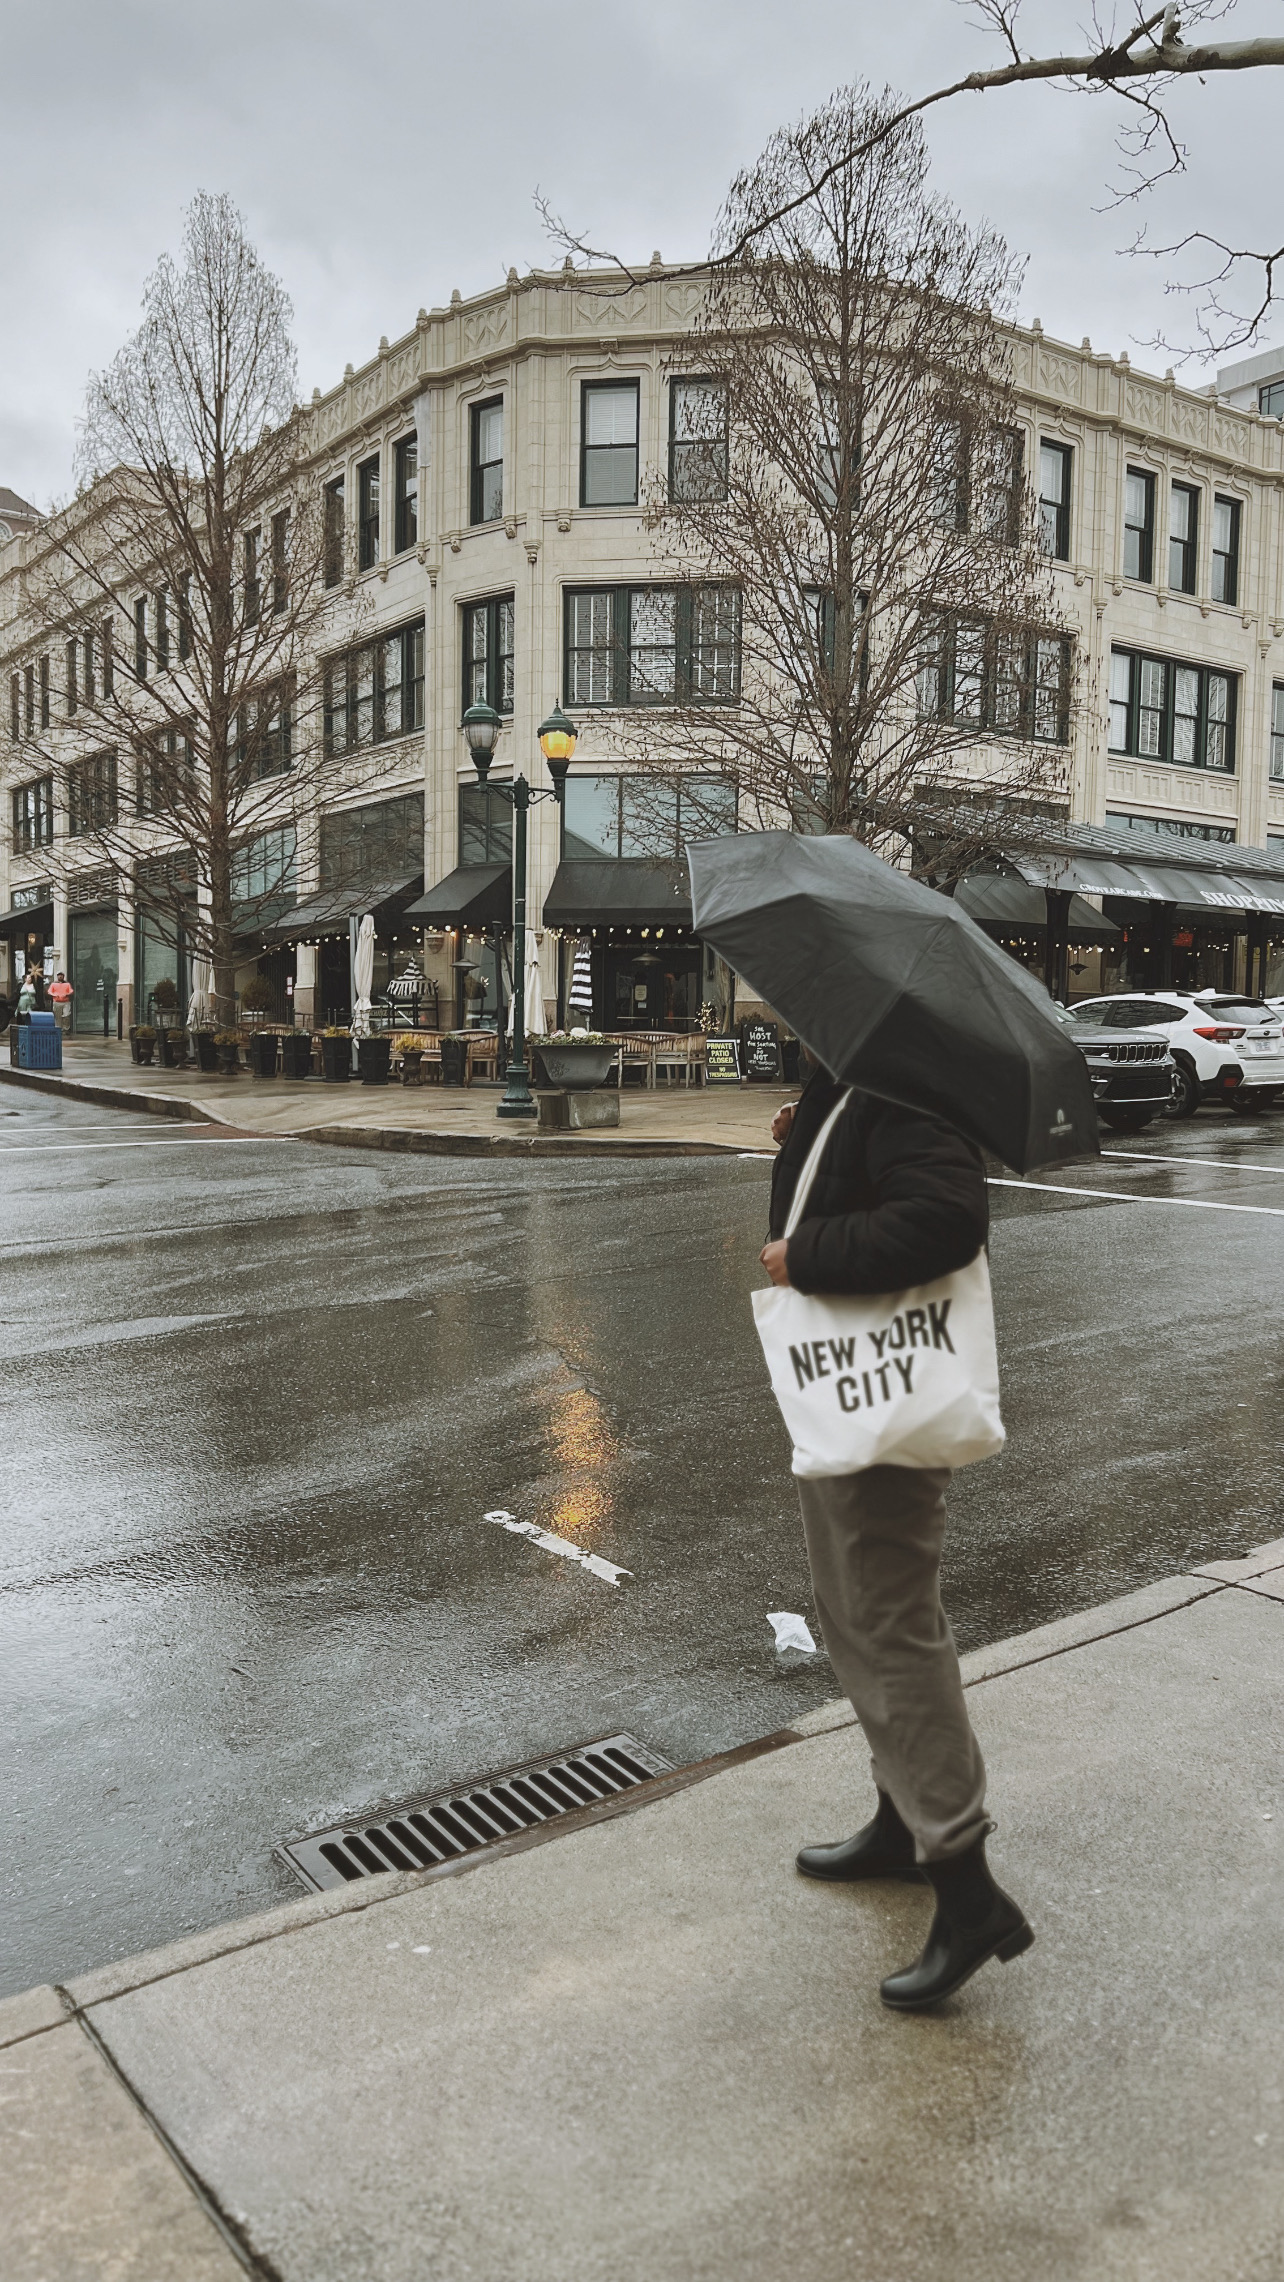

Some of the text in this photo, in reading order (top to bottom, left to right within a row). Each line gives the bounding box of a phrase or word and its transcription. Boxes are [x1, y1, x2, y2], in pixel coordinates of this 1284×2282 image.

[1079, 883, 1165, 900] GROVEARCADE.COM
[1200, 891, 1284, 912] SHOPPIN
[749, 1031, 771, 1040] HOST
[789, 1298, 957, 1392] NEW YORK
[836, 1354, 914, 1413] CITY
